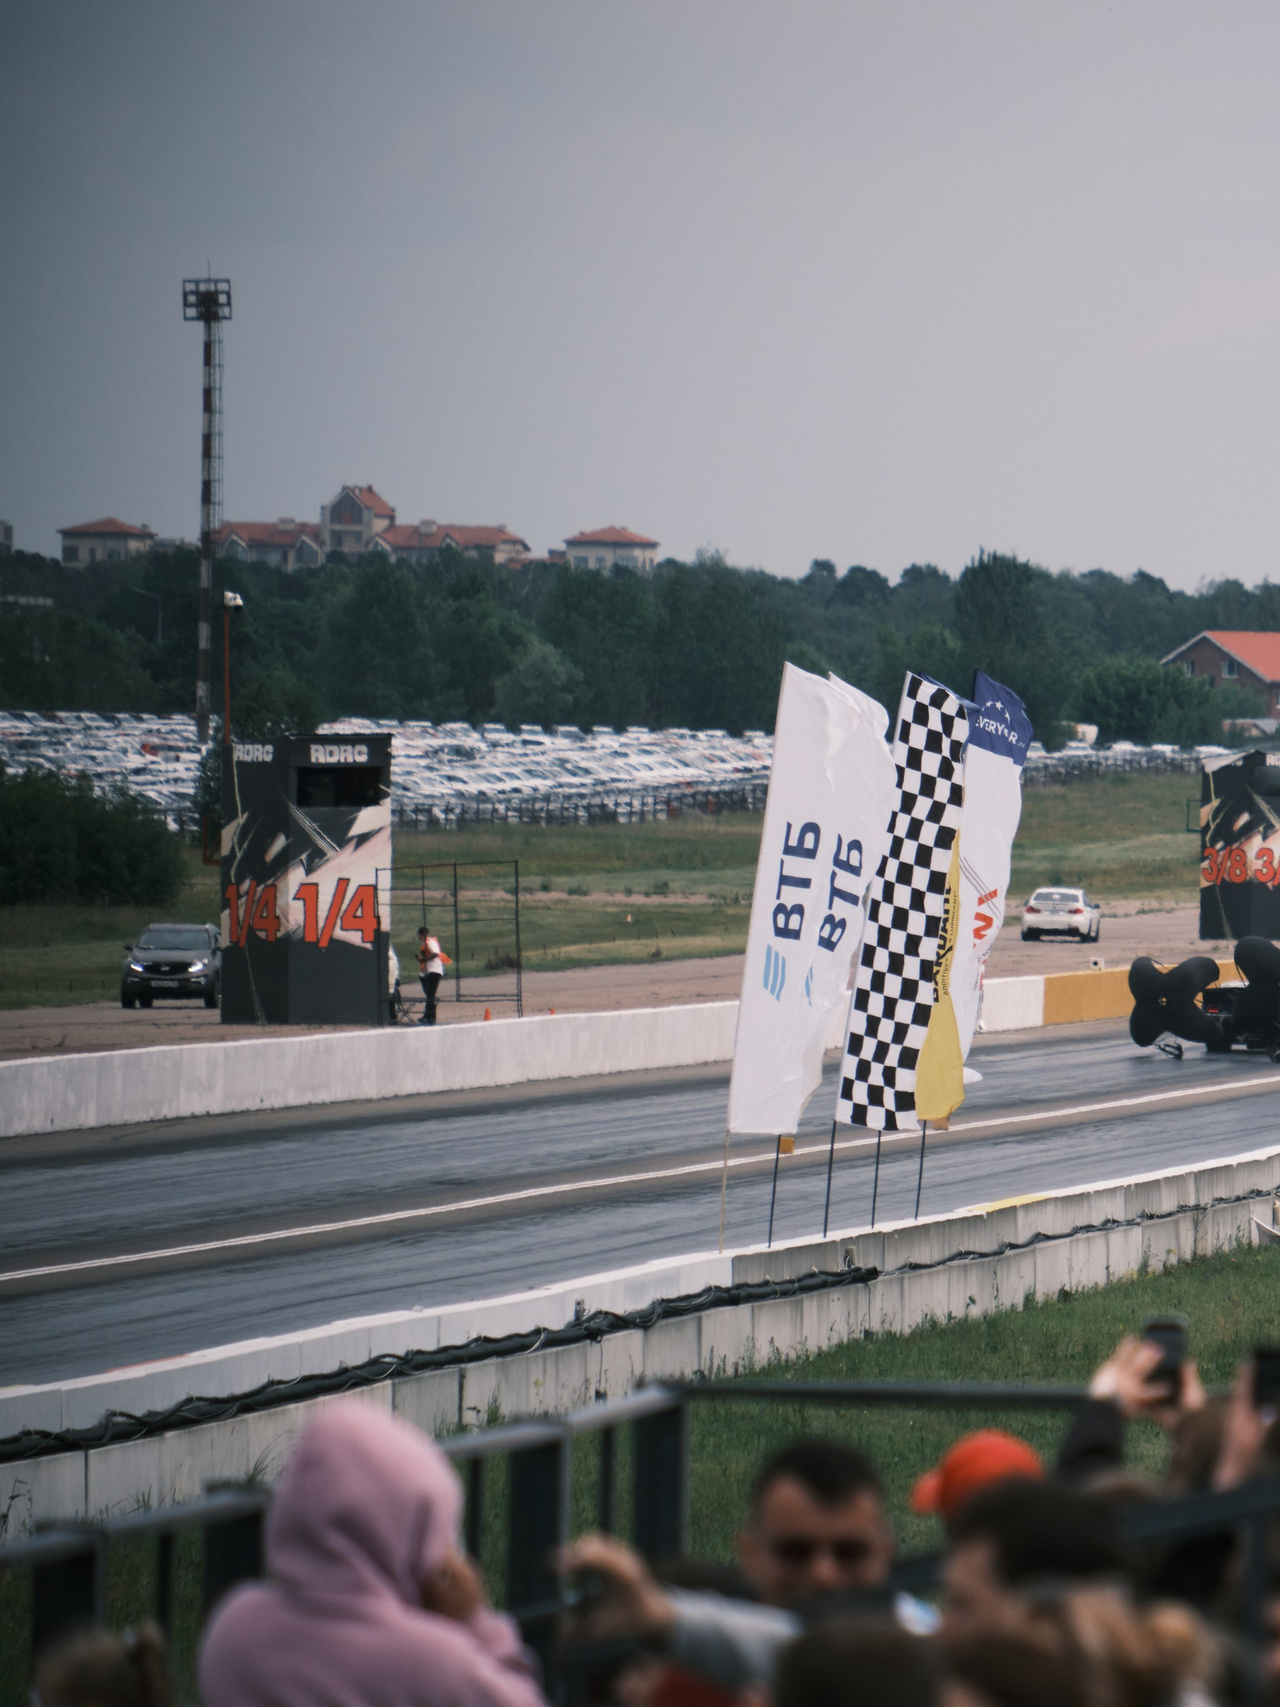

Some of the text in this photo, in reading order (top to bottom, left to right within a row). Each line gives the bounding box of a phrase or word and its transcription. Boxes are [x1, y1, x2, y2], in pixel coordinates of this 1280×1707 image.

[310, 744, 369, 763] RDRC
[772, 821, 822, 941] ВТБ
[817, 833, 863, 952] ВТБ
[1202, 845, 1248, 886] 3/8
[225, 880, 281, 948] 1/4
[293, 878, 378, 948] 1/4
